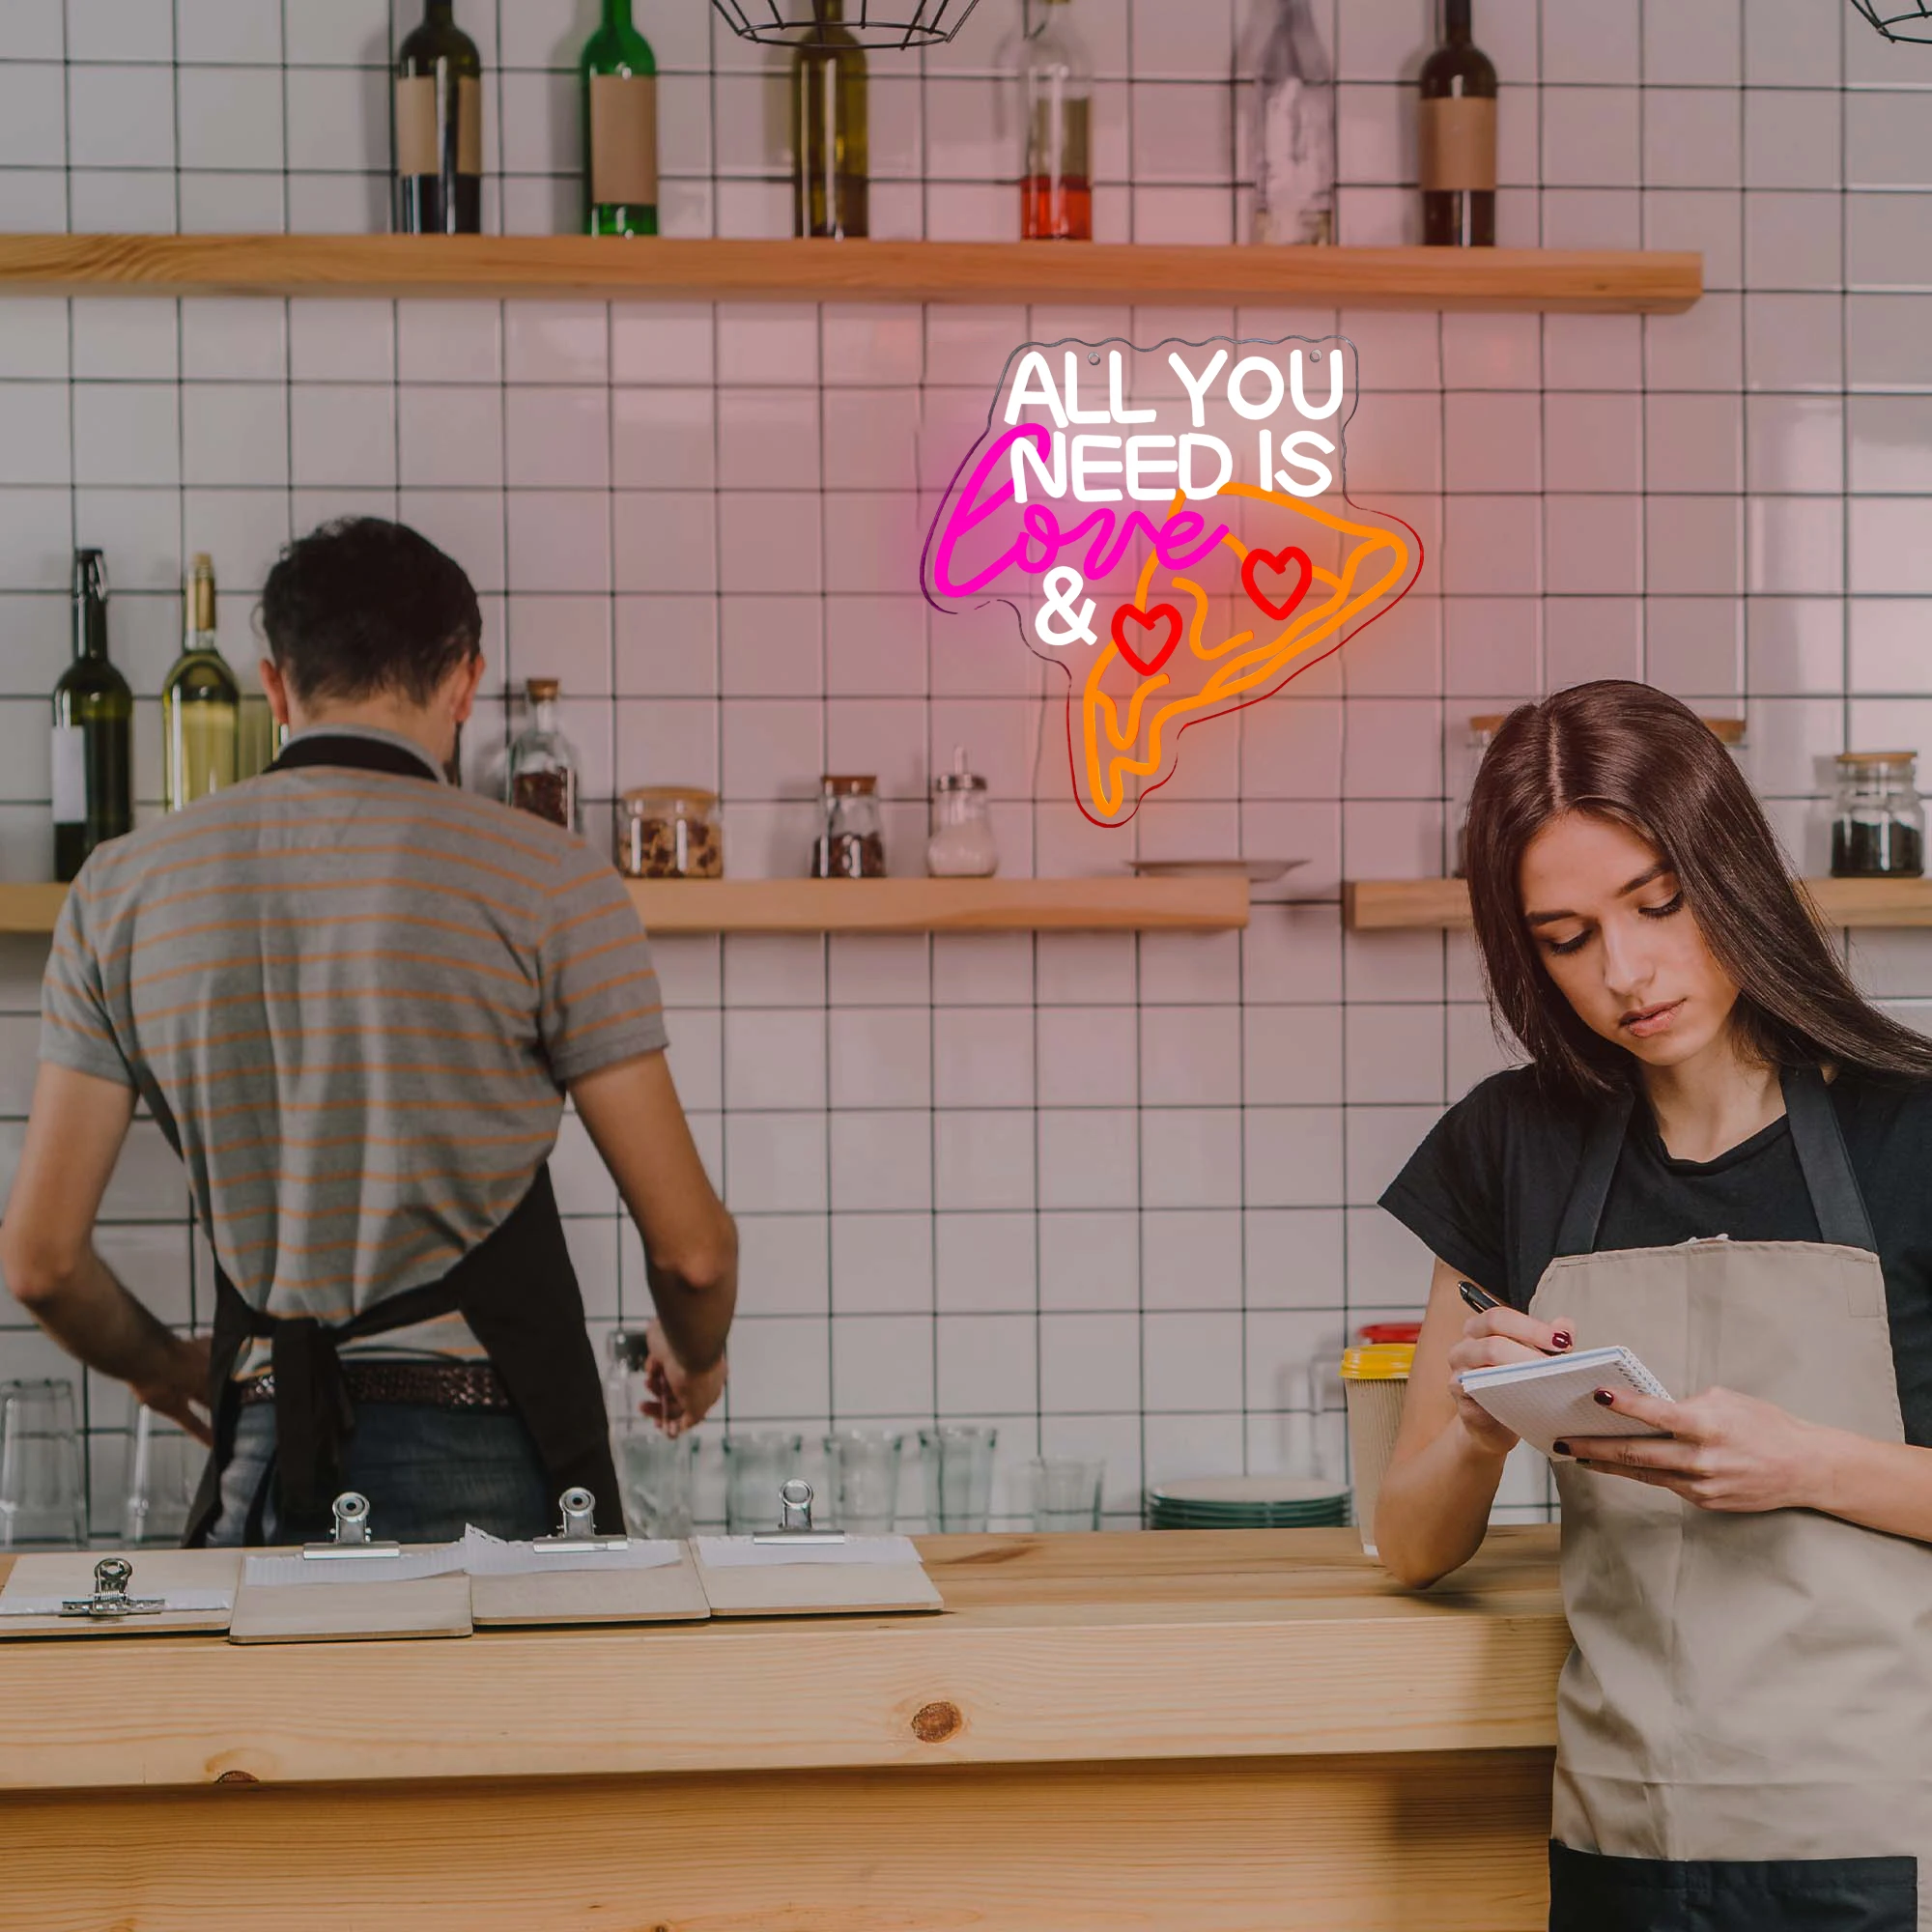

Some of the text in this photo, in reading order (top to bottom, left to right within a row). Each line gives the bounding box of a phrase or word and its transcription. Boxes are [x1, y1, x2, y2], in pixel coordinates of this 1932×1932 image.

[1004, 349, 1344, 428] ALL YOU
[1010, 429, 1336, 503] NEED IS
[1035, 565, 1098, 646] &
